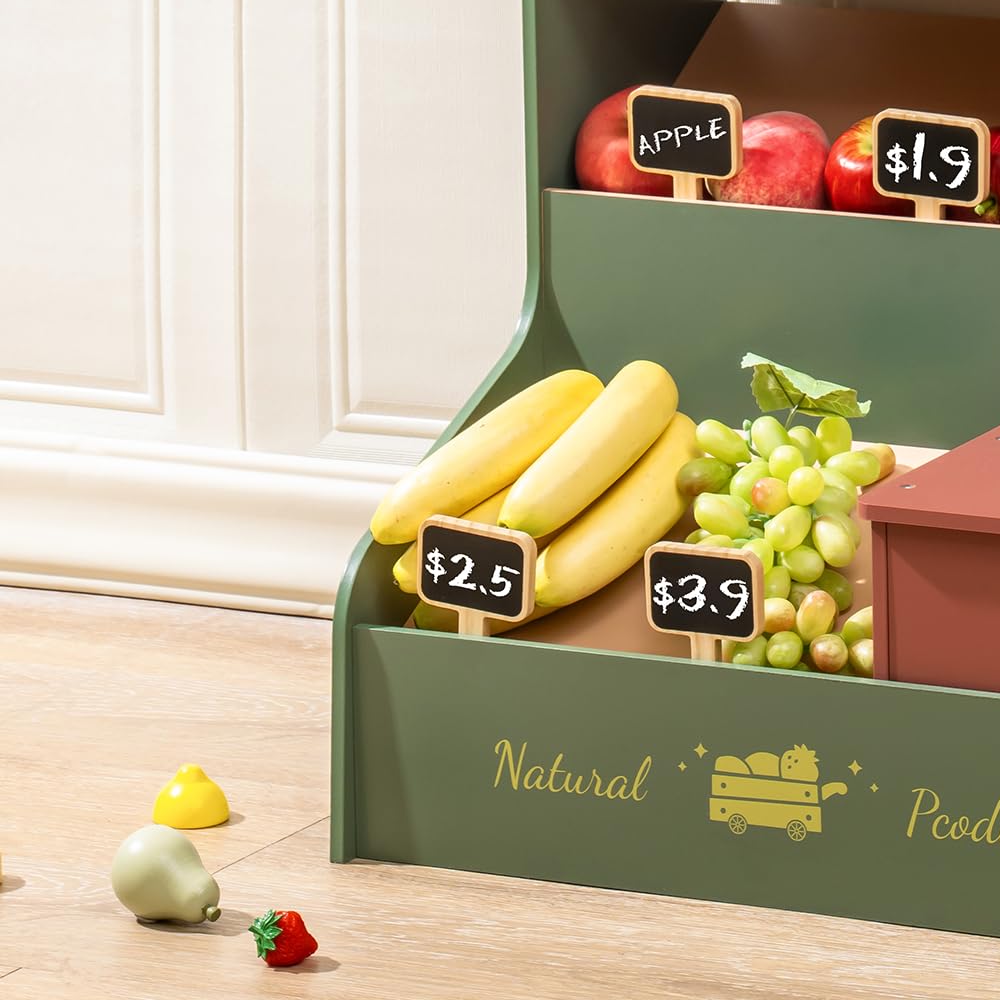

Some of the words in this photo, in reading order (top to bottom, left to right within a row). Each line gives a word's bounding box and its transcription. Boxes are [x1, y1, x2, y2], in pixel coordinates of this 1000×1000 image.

[638, 117, 728, 156] APPLE
[884, 131, 972, 189] $1.9
[424, 547, 521, 597] $2.5
[653, 574, 750, 620] $3.9
[494, 739, 652, 802] Natural
